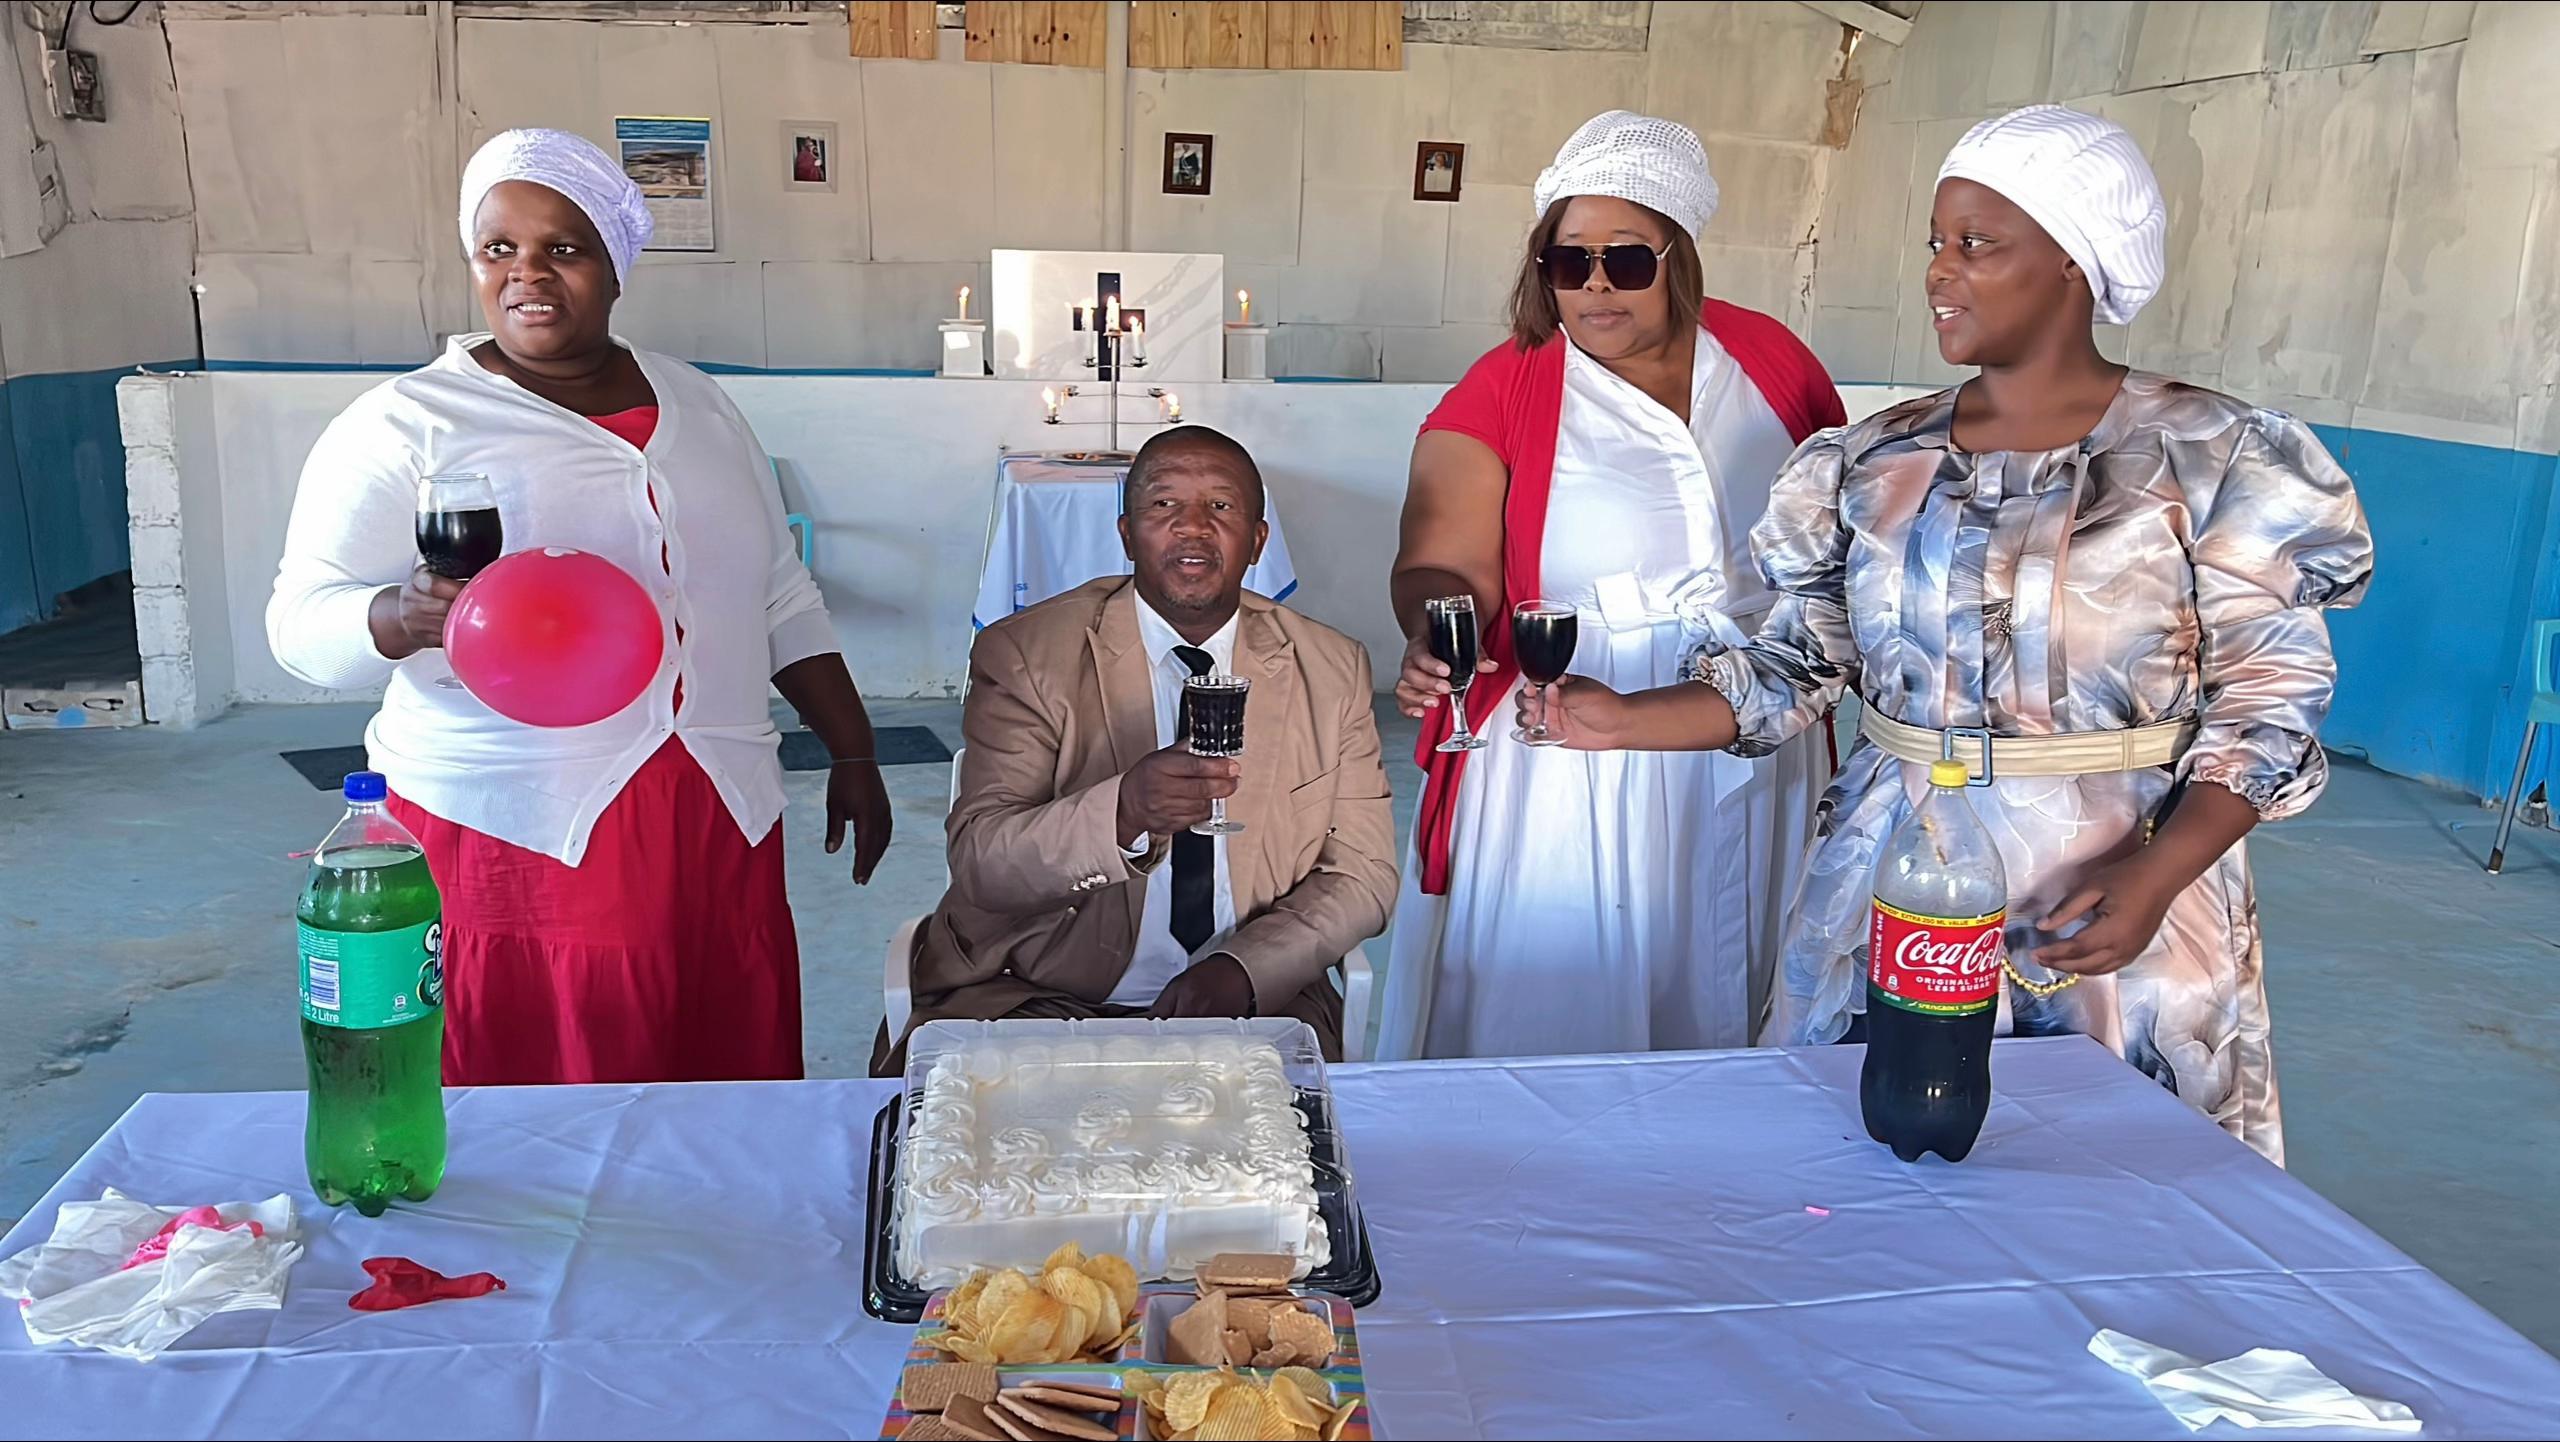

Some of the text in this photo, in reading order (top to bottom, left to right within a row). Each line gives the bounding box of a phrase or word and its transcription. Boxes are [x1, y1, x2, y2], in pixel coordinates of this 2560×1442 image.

[1873, 912, 1884, 983] RECYCLE ME
[1916, 976, 1970, 986] ORIGINAL
[1927, 981, 1990, 992] LESS SUGAR
[311, 1008, 317, 1019] 2
[318, 1009, 340, 1024] Litre
